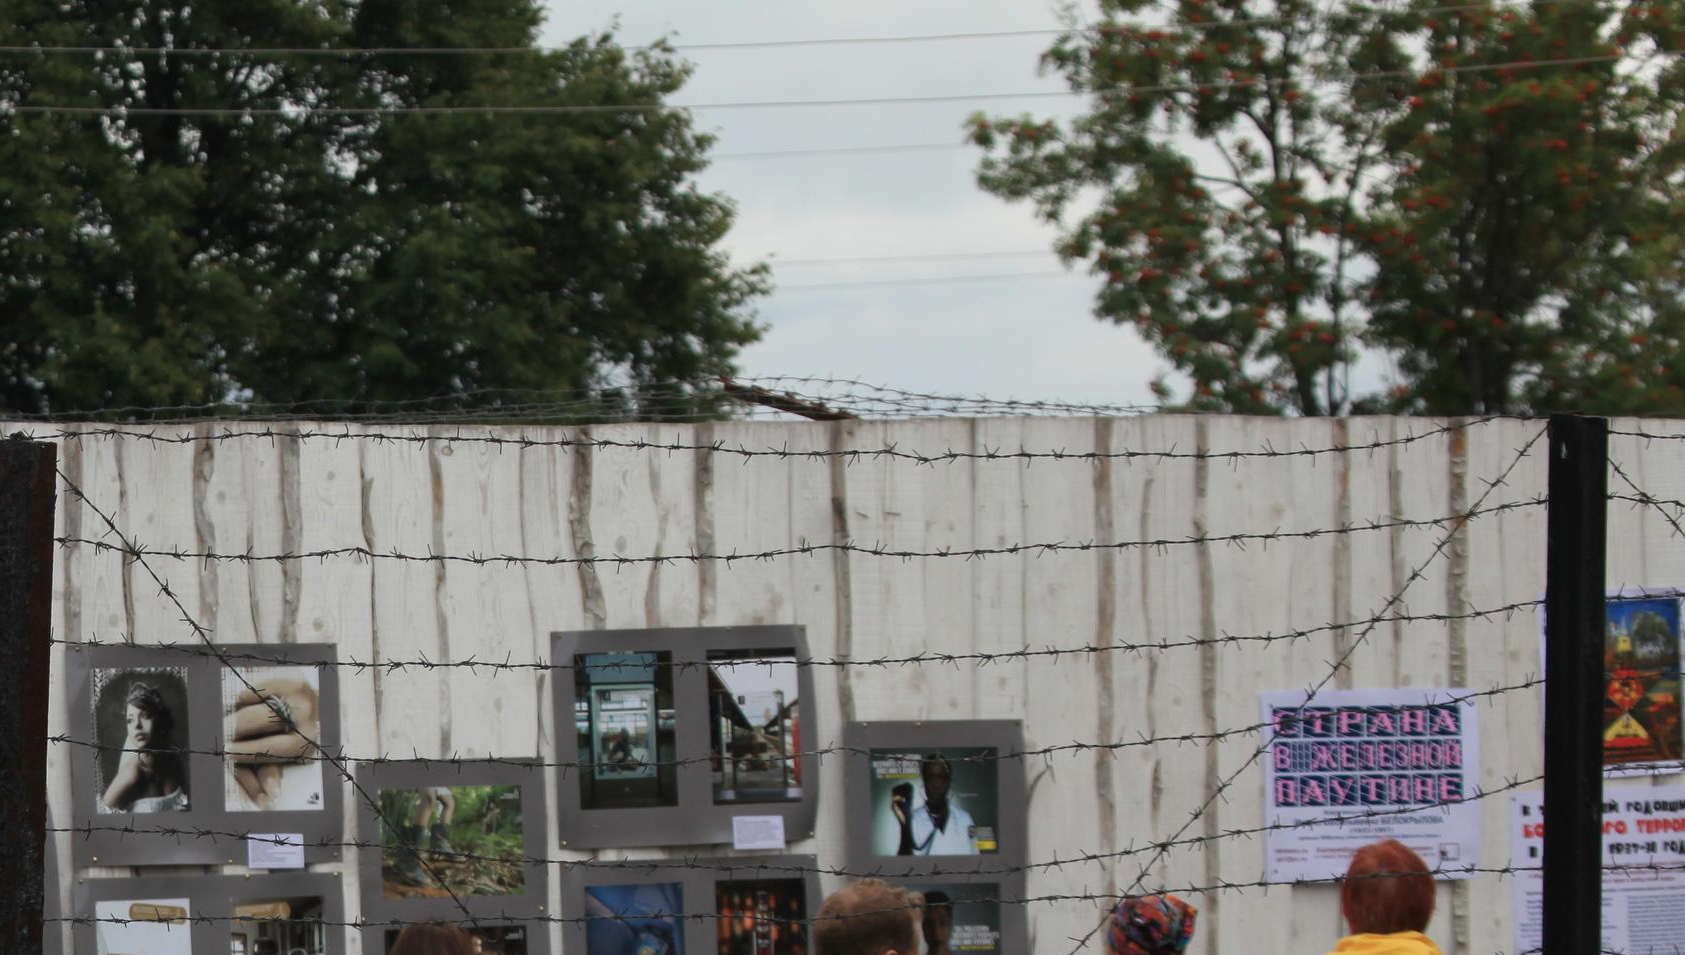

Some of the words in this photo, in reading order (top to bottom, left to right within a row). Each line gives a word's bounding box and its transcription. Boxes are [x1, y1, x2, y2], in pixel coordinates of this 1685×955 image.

[1273, 706, 1458, 738] СТРАНА
[1312, 740, 1462, 771] ЖЕЛЕЗНОЙ
[1275, 776, 1462, 805] ПАУТИНЕ
